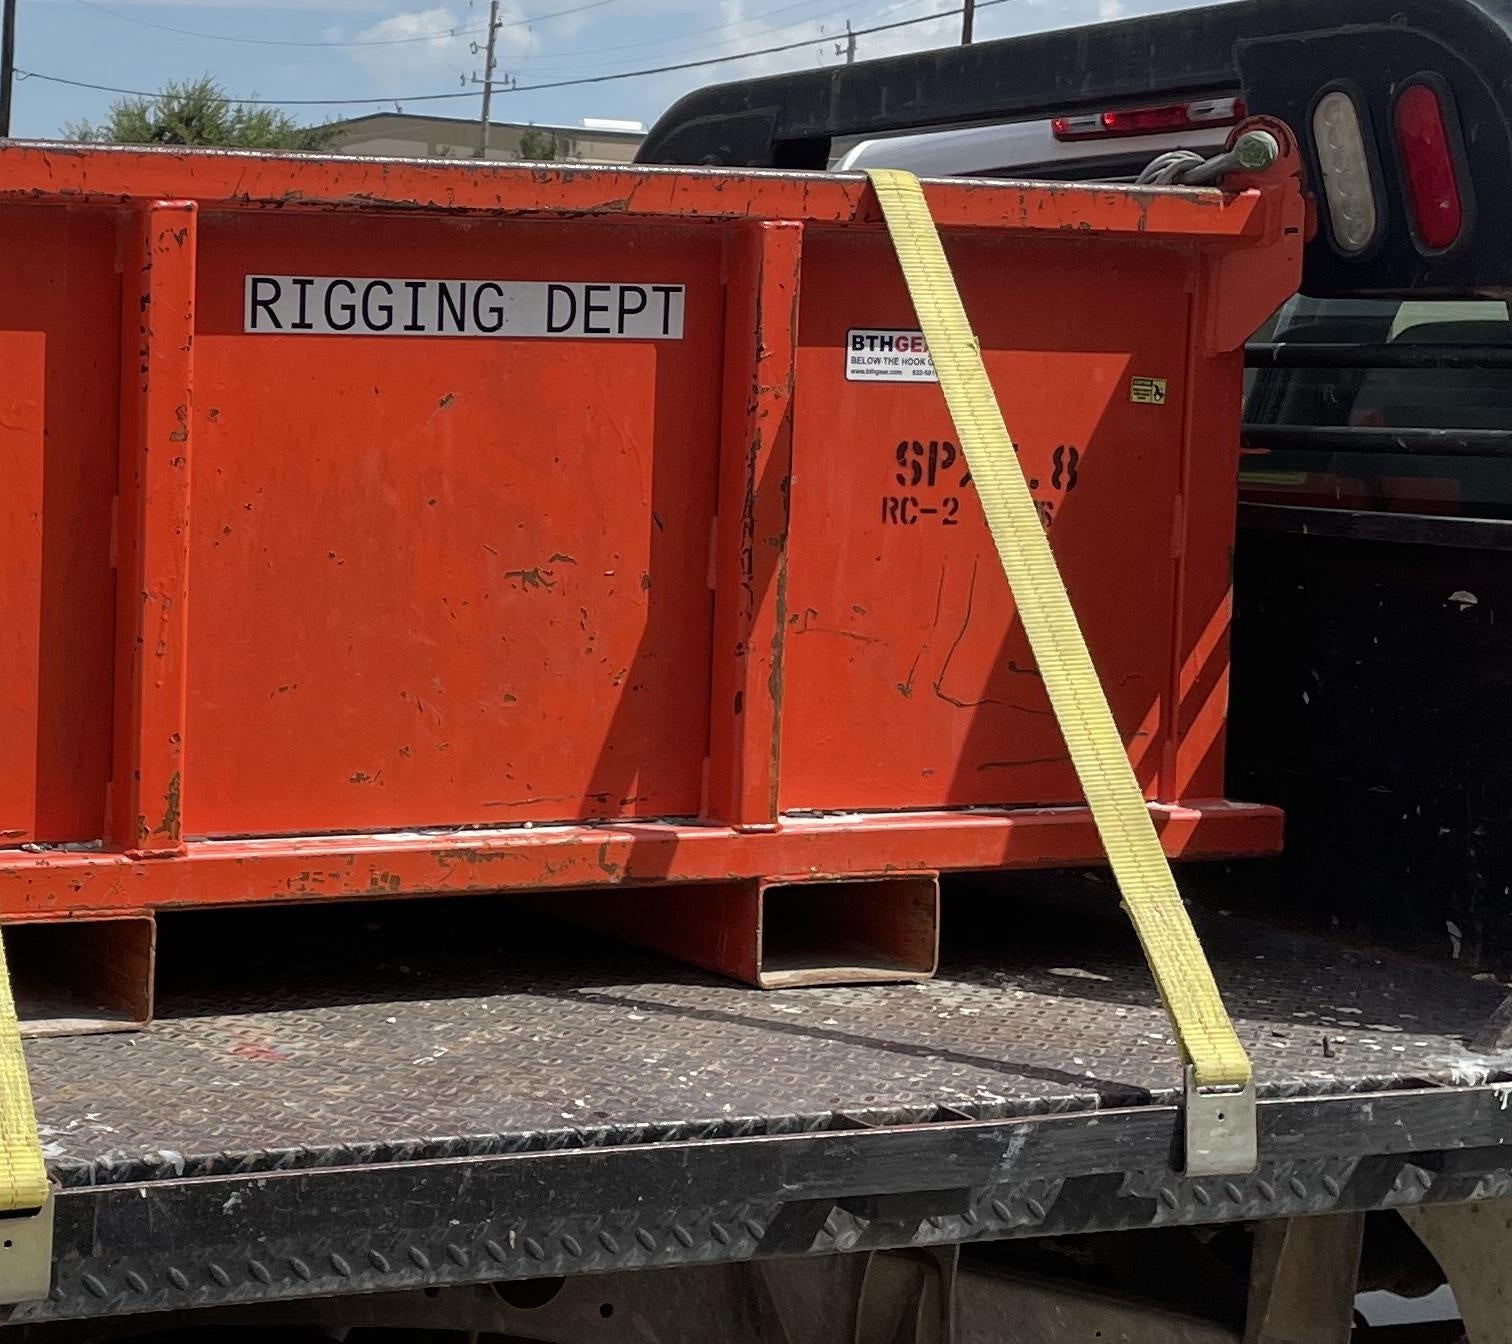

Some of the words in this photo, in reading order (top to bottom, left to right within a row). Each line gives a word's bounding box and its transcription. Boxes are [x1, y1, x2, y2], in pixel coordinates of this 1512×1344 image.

[249, 276, 505, 334] RIGGING
[546, 283, 684, 336] DEPT
[851, 334, 929, 353] BTHGE
